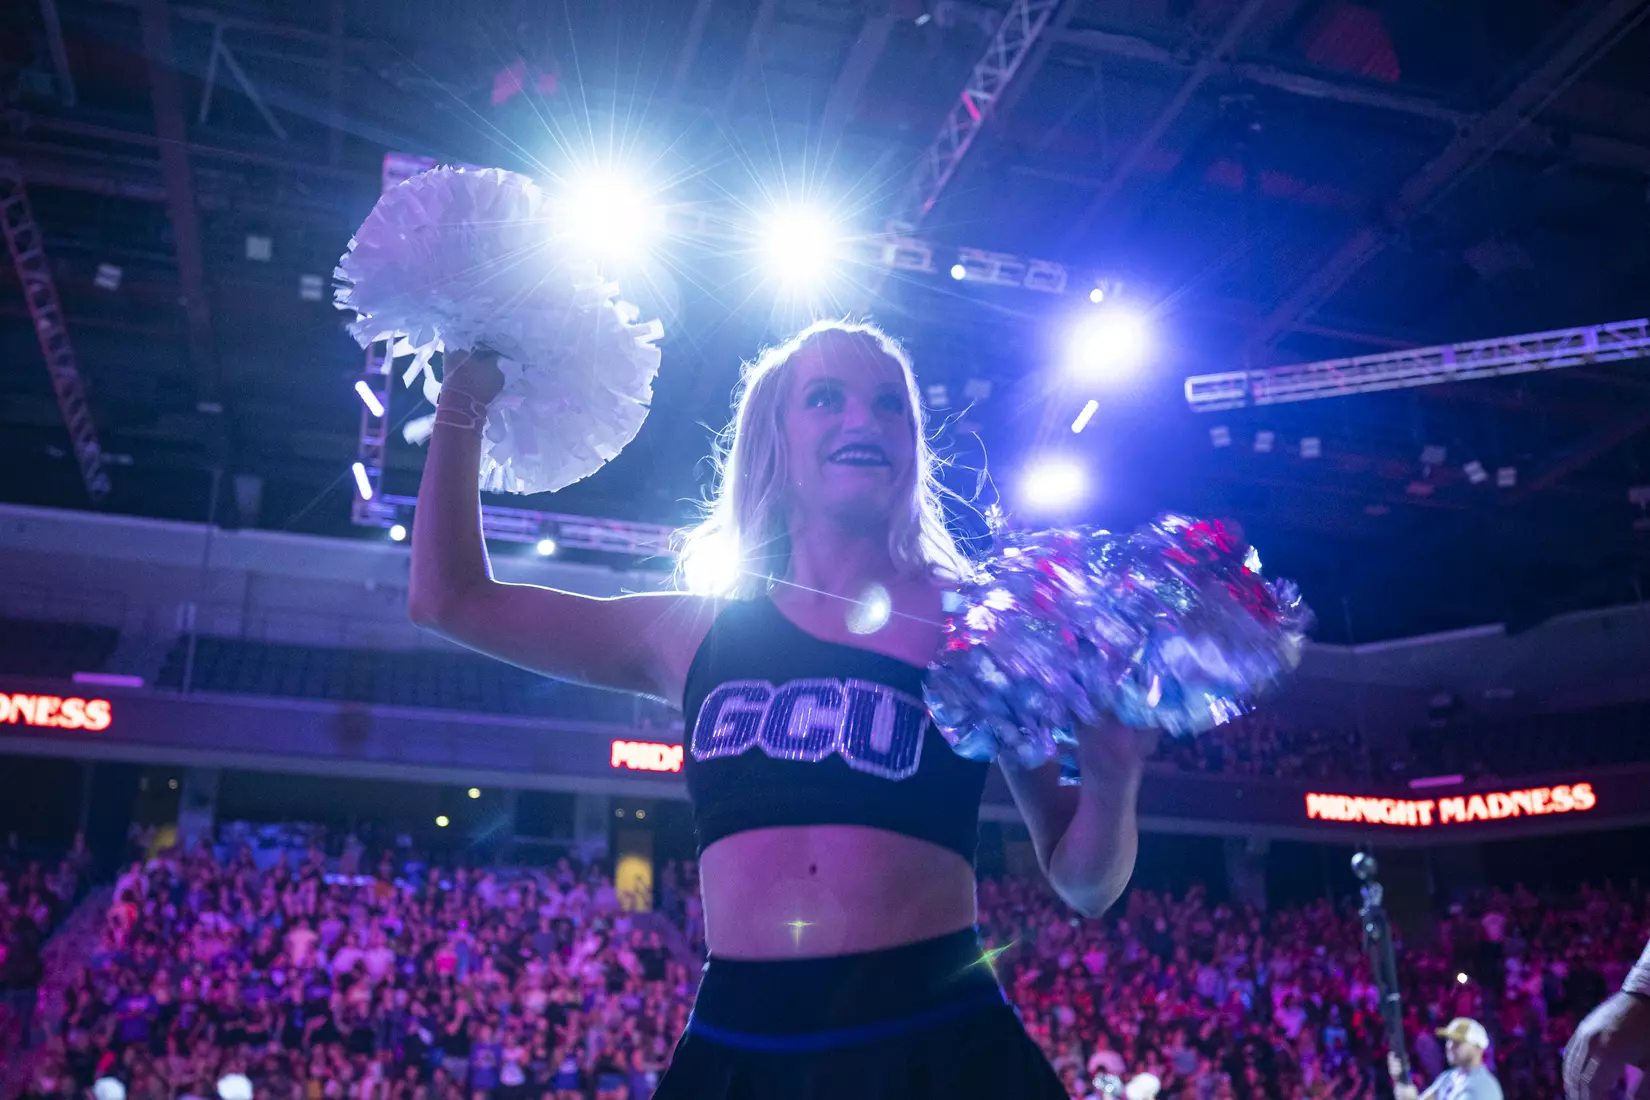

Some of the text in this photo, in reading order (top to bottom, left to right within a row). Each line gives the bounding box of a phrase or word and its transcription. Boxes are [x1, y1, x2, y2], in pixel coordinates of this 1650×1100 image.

[690, 677, 930, 782] GCU
[1304, 782, 1597, 827] MIDNIGHT MADNESS
